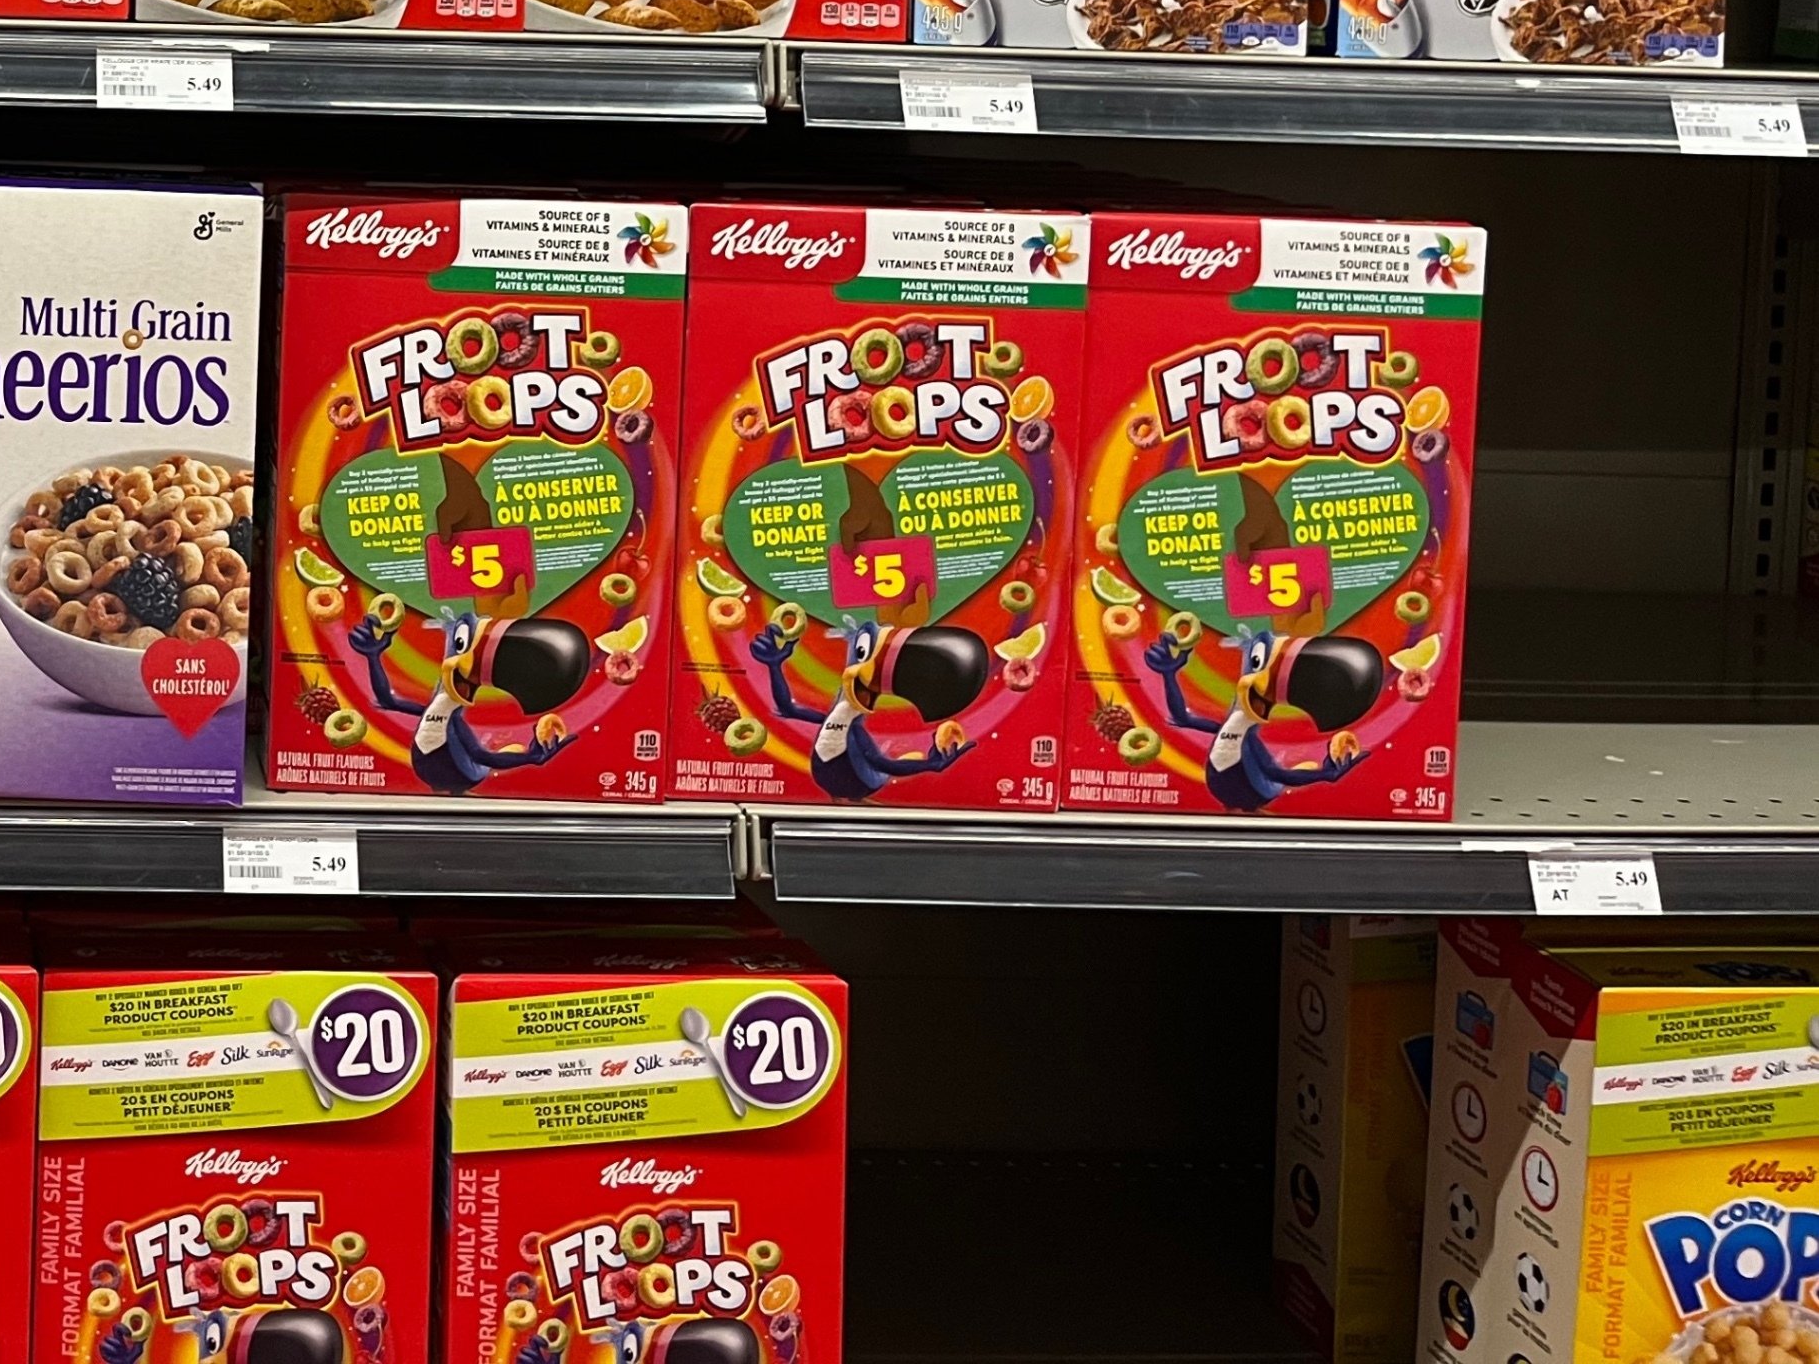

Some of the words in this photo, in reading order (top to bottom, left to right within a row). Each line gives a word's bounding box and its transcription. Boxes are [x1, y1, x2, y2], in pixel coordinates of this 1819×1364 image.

[187, 77, 221, 92] 5.49
[990, 99, 1023, 113] 5.49
[1759, 119, 1790, 133] 5.49
[307, 208, 440, 259] Kellogg's
[711, 219, 848, 269] Kellogg's
[1108, 229, 1242, 279] Kellogg's
[20, 297, 117, 337] Multi
[131, 300, 232, 341] Grain
[362, 313, 581, 402] FROOT
[768, 323, 985, 414] FROOT
[1162, 333, 1381, 424] FROOT
[400, 372, 603, 439] LOOPS
[805, 382, 1006, 450] LOOPS
[1201, 393, 1401, 460] LOOPS
[348, 496, 390, 514] KEEP
[395, 493, 421, 510] OR
[495, 481, 506, 502] À
[513, 475, 618, 500] CONSERVER
[498, 506, 524, 524] OU
[529, 502, 541, 522] À
[547, 497, 622, 519] DONNER
[350, 515, 425, 537] DONATE
[312, 857, 346, 872] 5.49
[1616, 872, 1648, 887] 5.49
[1552, 888, 1569, 901] AT
[321, 1010, 404, 1077] $20
[733, 1017, 817, 1084] $20
[1715, 1203, 1780, 1228] CORN
